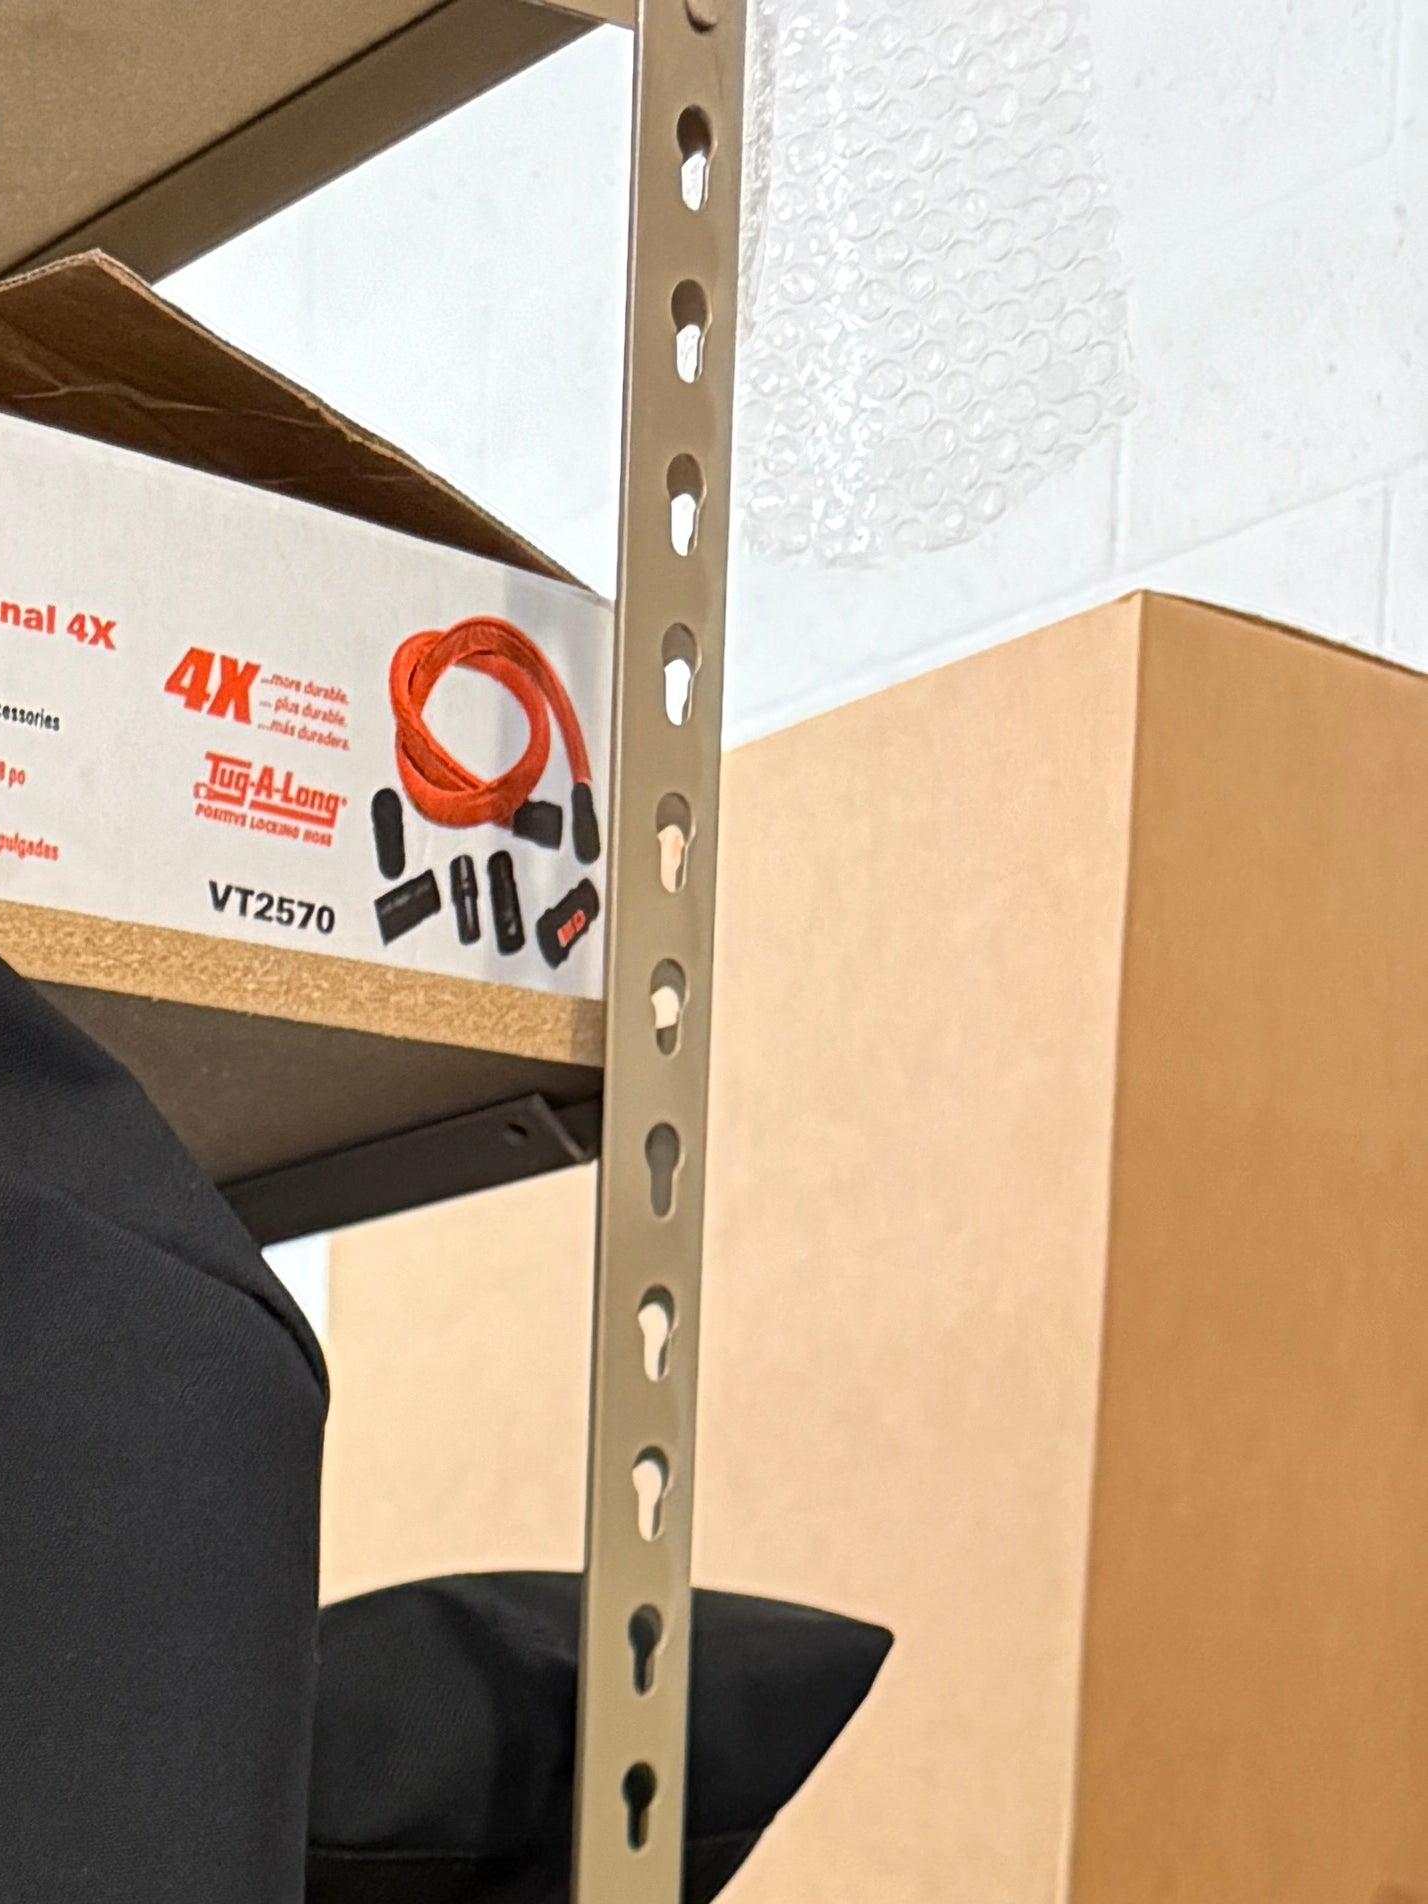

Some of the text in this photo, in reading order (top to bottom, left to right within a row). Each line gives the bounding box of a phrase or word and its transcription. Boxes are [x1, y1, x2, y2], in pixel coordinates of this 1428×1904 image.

[66, 613, 117, 650] 4X
[164, 646, 261, 725] 4X
[9, 767, 26, 788] po
[208, 879, 336, 935] VT2570
